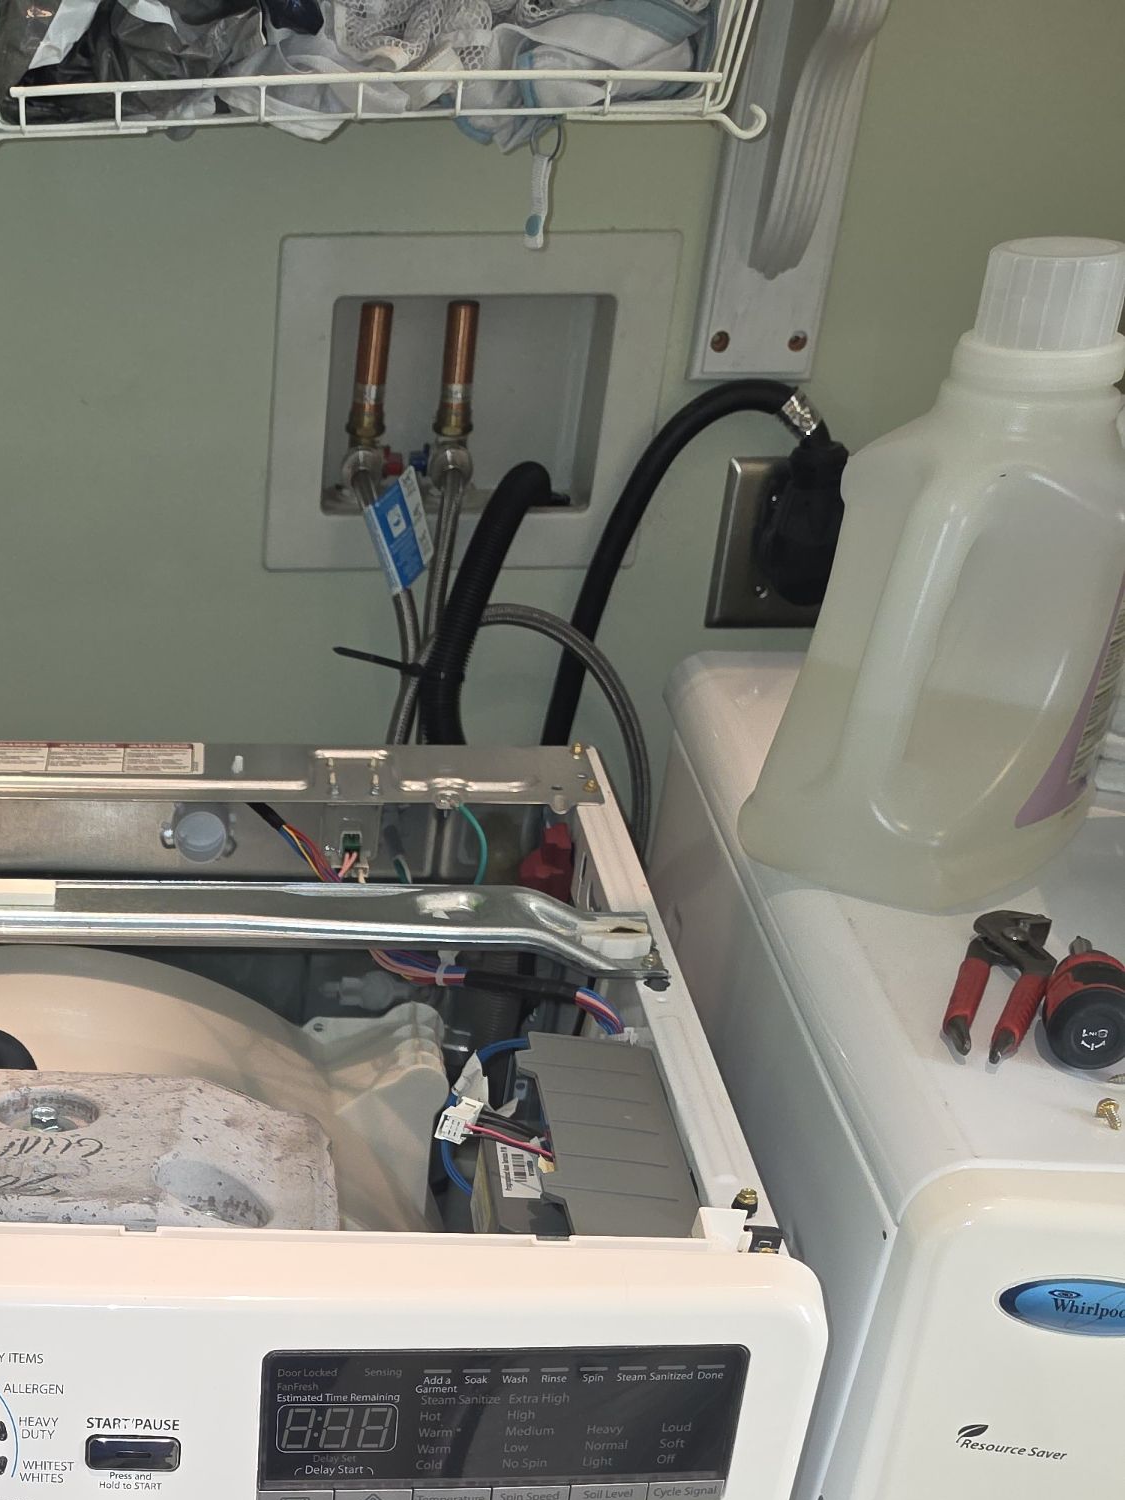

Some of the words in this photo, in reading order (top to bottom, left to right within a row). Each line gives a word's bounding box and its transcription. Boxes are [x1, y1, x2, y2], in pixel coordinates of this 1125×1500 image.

[1052, 1297, 1125, 1320] Whirlpoo
[8, 1353, 44, 1364] ITEMS
[277, 1369, 301, 1377] Door
[303, 1368, 338, 1377] Locked
[364, 1368, 403, 1379] Sensing
[617, 1373, 647, 1382] Steam
[649, 1371, 693, 1381] Sanitized
[697, 1371, 723, 1381] Done
[423, 1376, 443, 1385] Add
[464, 1375, 488, 1384] Soak
[502, 1375, 528, 1384] Wash
[541, 1374, 567, 1383] Rinse
[583, 1374, 604, 1385] Spin
[3, 1383, 65, 1396] ALLERGEN
[277, 1382, 319, 1391] FanFresh
[415, 1385, 458, 1394] Garment
[277, 1393, 323, 1402] Estimated
[325, 1393, 348, 1402] Time
[351, 1392, 400, 1403] Remaining
[421, 1395, 456, 1406] Steam
[458, 1394, 501, 1405] Sanitize
[509, 1394, 538, 1404] Extra
[542, 1394, 570, 1406] High
[18, 1416, 59, 1427] HEAVY
[420, 1411, 441, 1421] Hot
[507, 1410, 535, 1422] High
[506, 1425, 555, 1436] Medium
[587, 1425, 624, 1436] Heavy
[662, 1422, 692, 1433] Loud
[21, 1429, 55, 1440] DUTY
[417, 1445, 451, 1454] Warm
[504, 1443, 528, 1452] Low
[585, 1440, 628, 1451] Normal
[660, 1439, 685, 1449] Soft
[960, 1438, 1026, 1456] Resource
[1027, 1447, 1068, 1461] Saver
[313, 1455, 336, 1464] Delay
[341, 1455, 357, 1463] Set
[502, 1459, 519, 1468] No
[523, 1458, 547, 1471] Spin
[582, 1457, 612, 1468] Light
[657, 1454, 676, 1464] Off
[22, 1460, 75, 1471] WHITEST
[305, 1465, 335, 1475] Delay
[337, 1465, 364, 1474] Start
[416, 1460, 443, 1471] Cold
[19, 1472, 64, 1484] WHITES
[109, 1471, 133, 1480] Press
[99, 1481, 120, 1490] Hold
[123, 1482, 132, 1490] to
[134, 1482, 162, 1490] START
[583, 1490, 603, 1499] Soil
[605, 1489, 633, 1499] Level
[654, 1488, 682, 1499] Cycle
[685, 1486, 717, 1498] Signal
